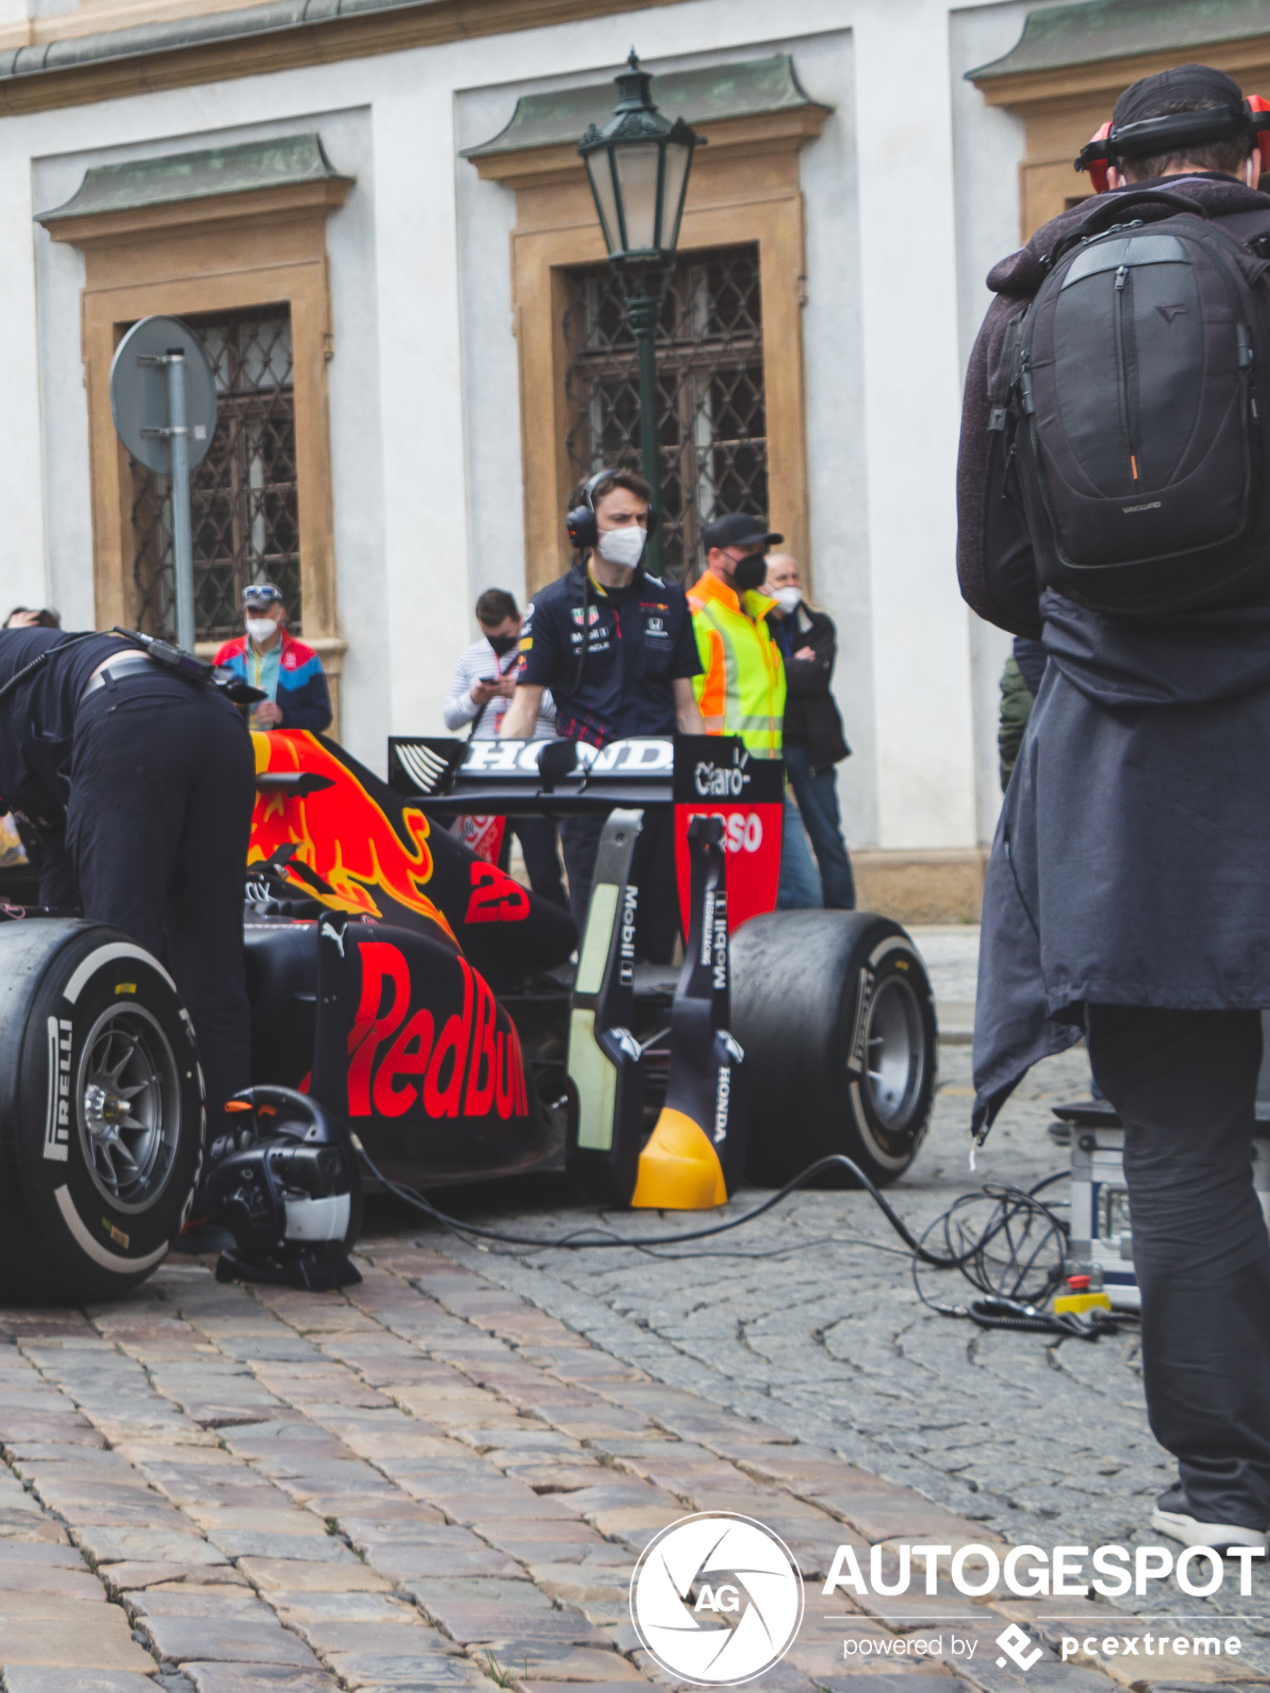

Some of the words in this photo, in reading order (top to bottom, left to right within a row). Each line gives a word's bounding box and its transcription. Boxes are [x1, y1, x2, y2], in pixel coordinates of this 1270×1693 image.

[460, 739, 674, 771] HND
[620, 885, 638, 958] Mobil
[713, 919, 727, 989] Mobil
[43, 1015, 73, 1162] PIRELLI
[713, 1066, 731, 1143] HONDA
